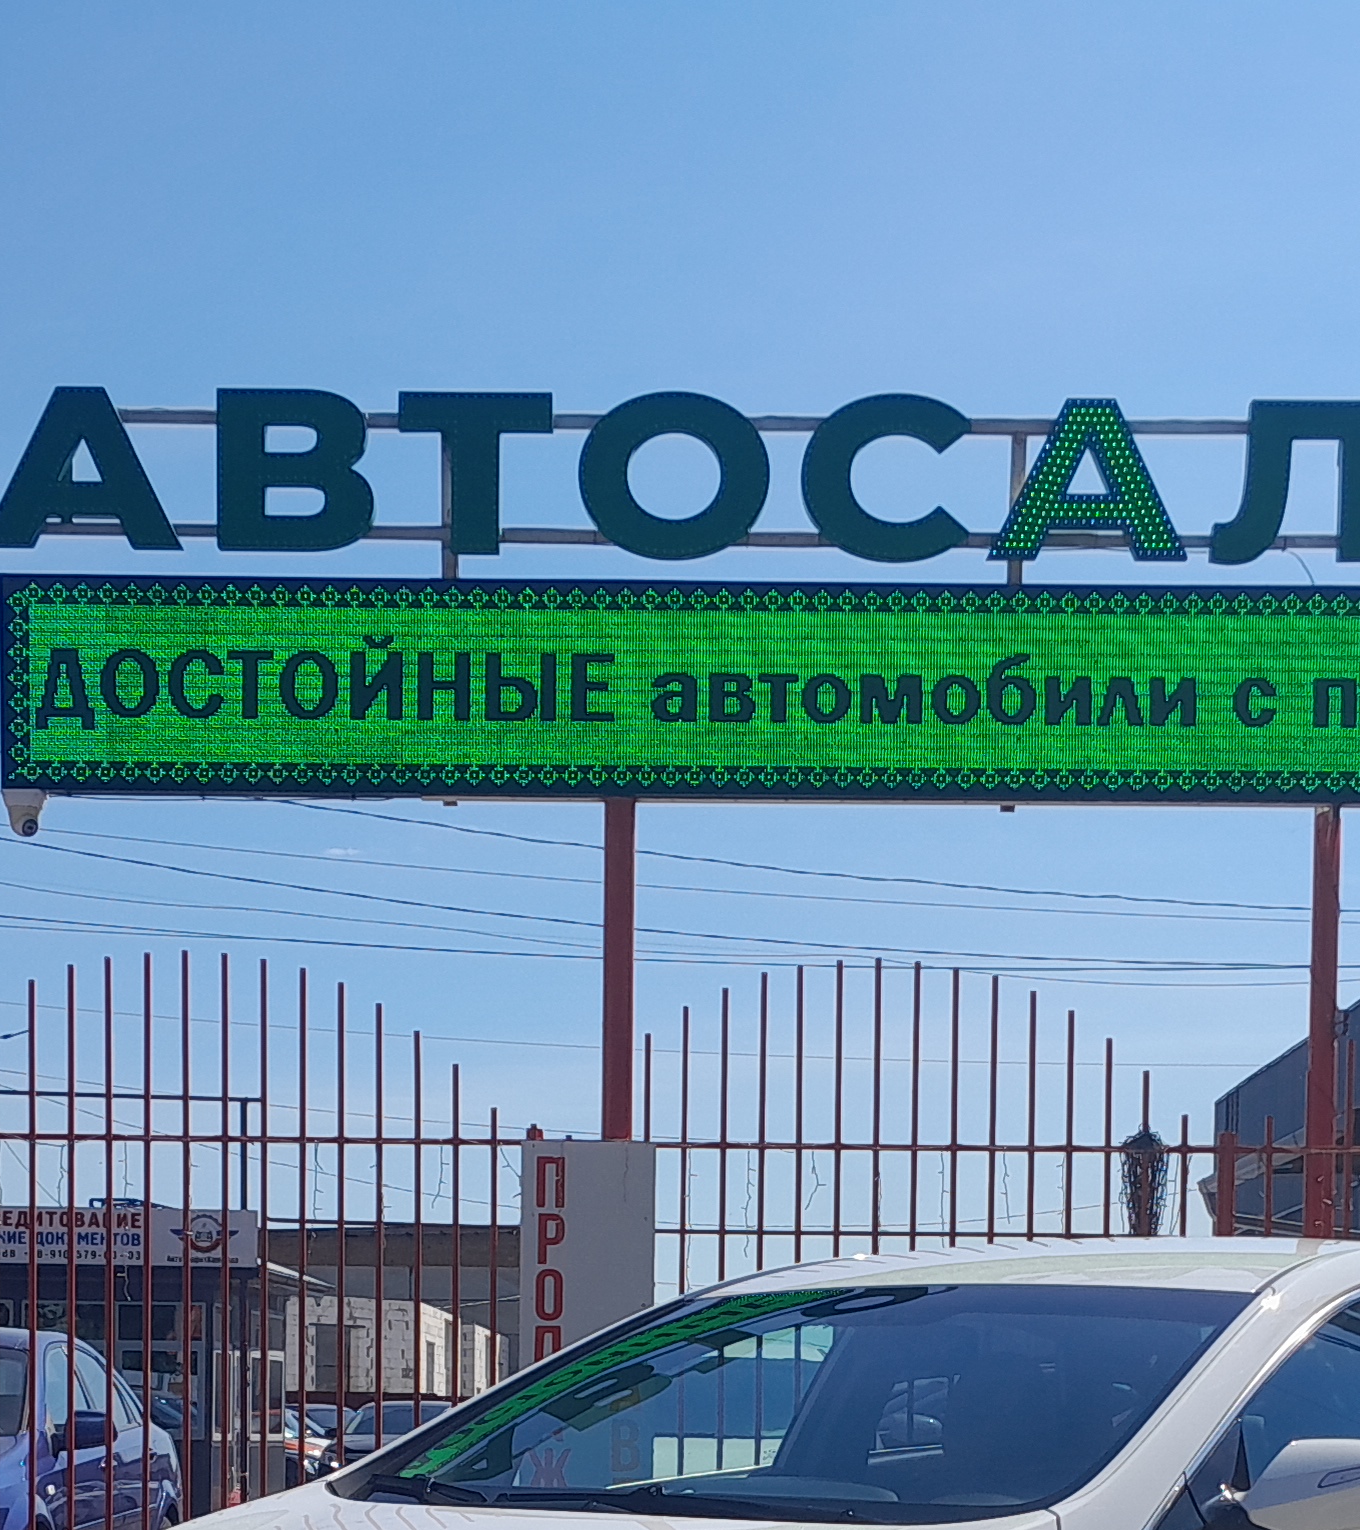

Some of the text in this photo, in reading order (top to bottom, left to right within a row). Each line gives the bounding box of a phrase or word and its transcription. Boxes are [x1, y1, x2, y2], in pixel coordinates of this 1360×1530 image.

[35, 635, 617, 730] ДОСТОЙНЫЕ
[650, 654, 1198, 727] автомобили
[1232, 676, 1278, 729] с
[36, 1231, 142, 1247] ДОКМЕНТОВ
